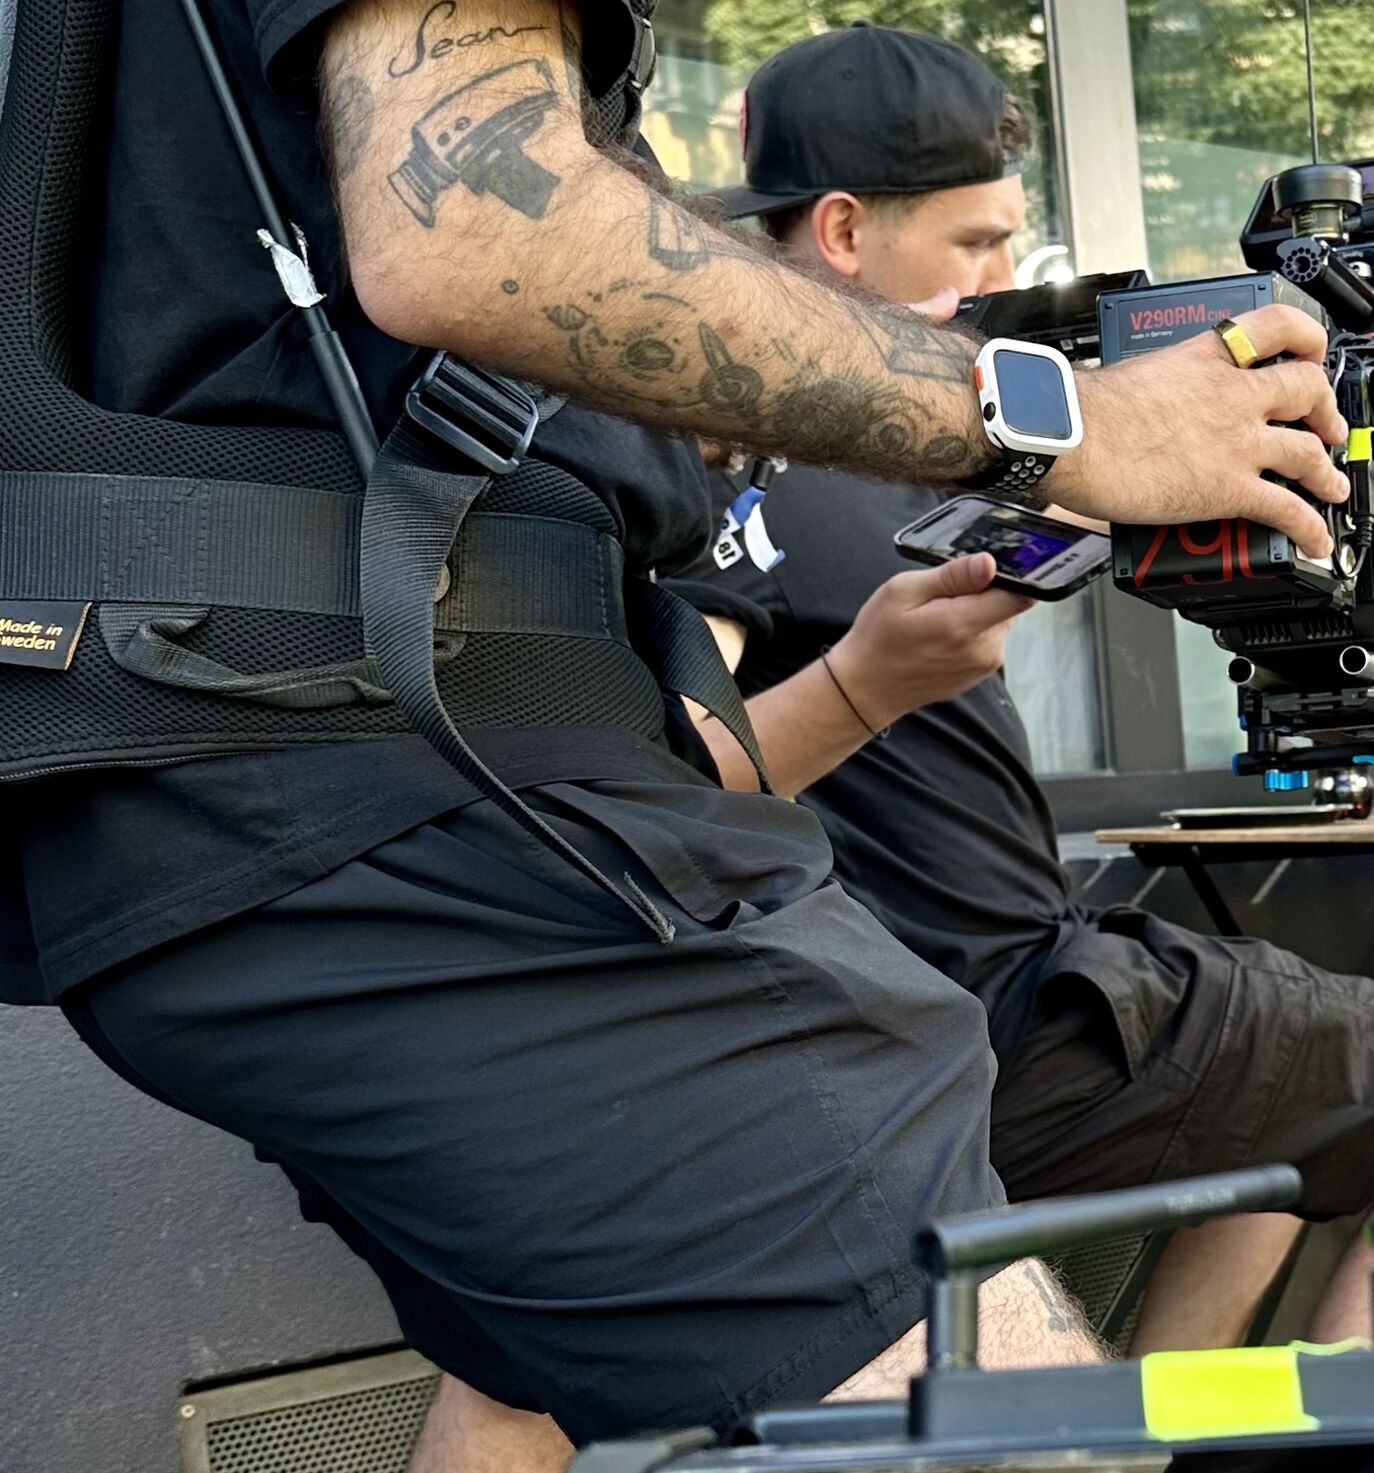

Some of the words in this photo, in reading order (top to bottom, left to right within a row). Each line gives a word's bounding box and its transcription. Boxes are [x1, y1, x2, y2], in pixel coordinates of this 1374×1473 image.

[389, 1, 550, 78] Sean
[1130, 304, 1205, 331] V290RM
[1207, 309, 1232, 322] CINE
[0, 618, 43, 634] Made
[46, 623, 63, 636] in
[0, 631, 56, 650] weden
